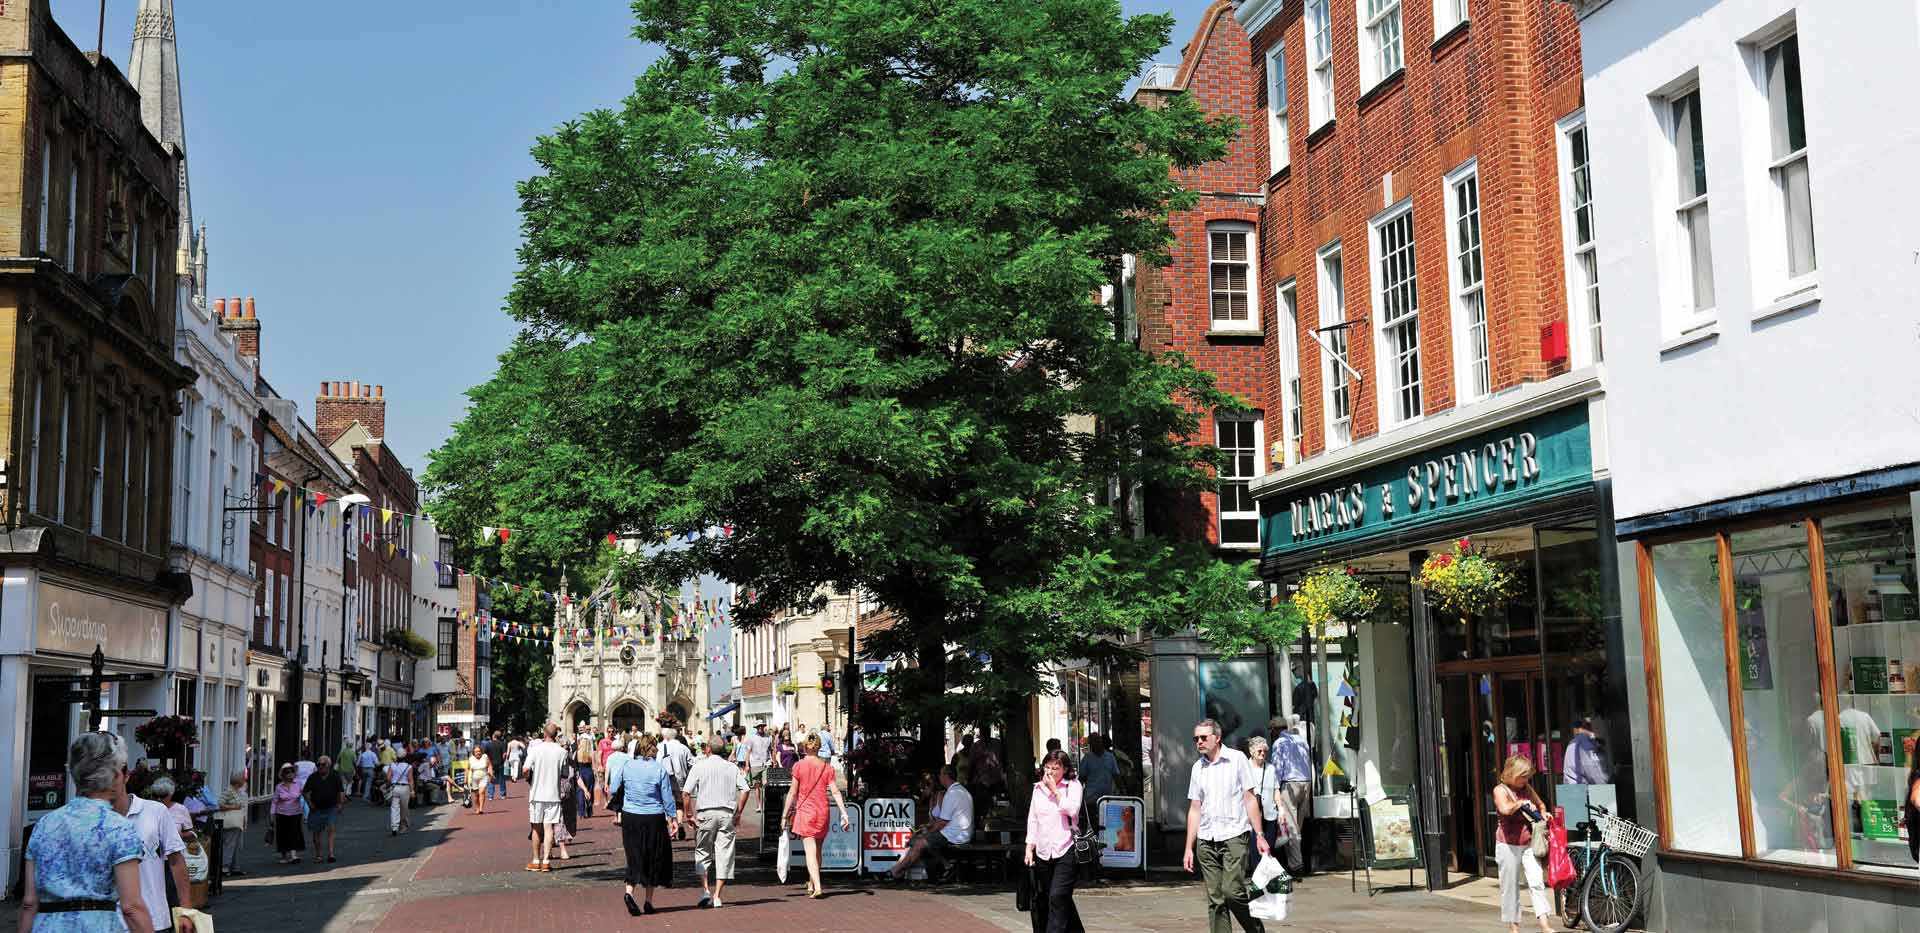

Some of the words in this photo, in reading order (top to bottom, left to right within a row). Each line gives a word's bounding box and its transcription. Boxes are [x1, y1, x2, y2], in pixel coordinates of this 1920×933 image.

[1290, 482, 1364, 538] MARKS
[1382, 484, 1394, 513] &
[1408, 432, 1540, 508] SPENCER
[48, 601, 107, 650] Superdrug
[868, 802, 911, 819] OAK
[868, 818, 911, 828] Furniture
